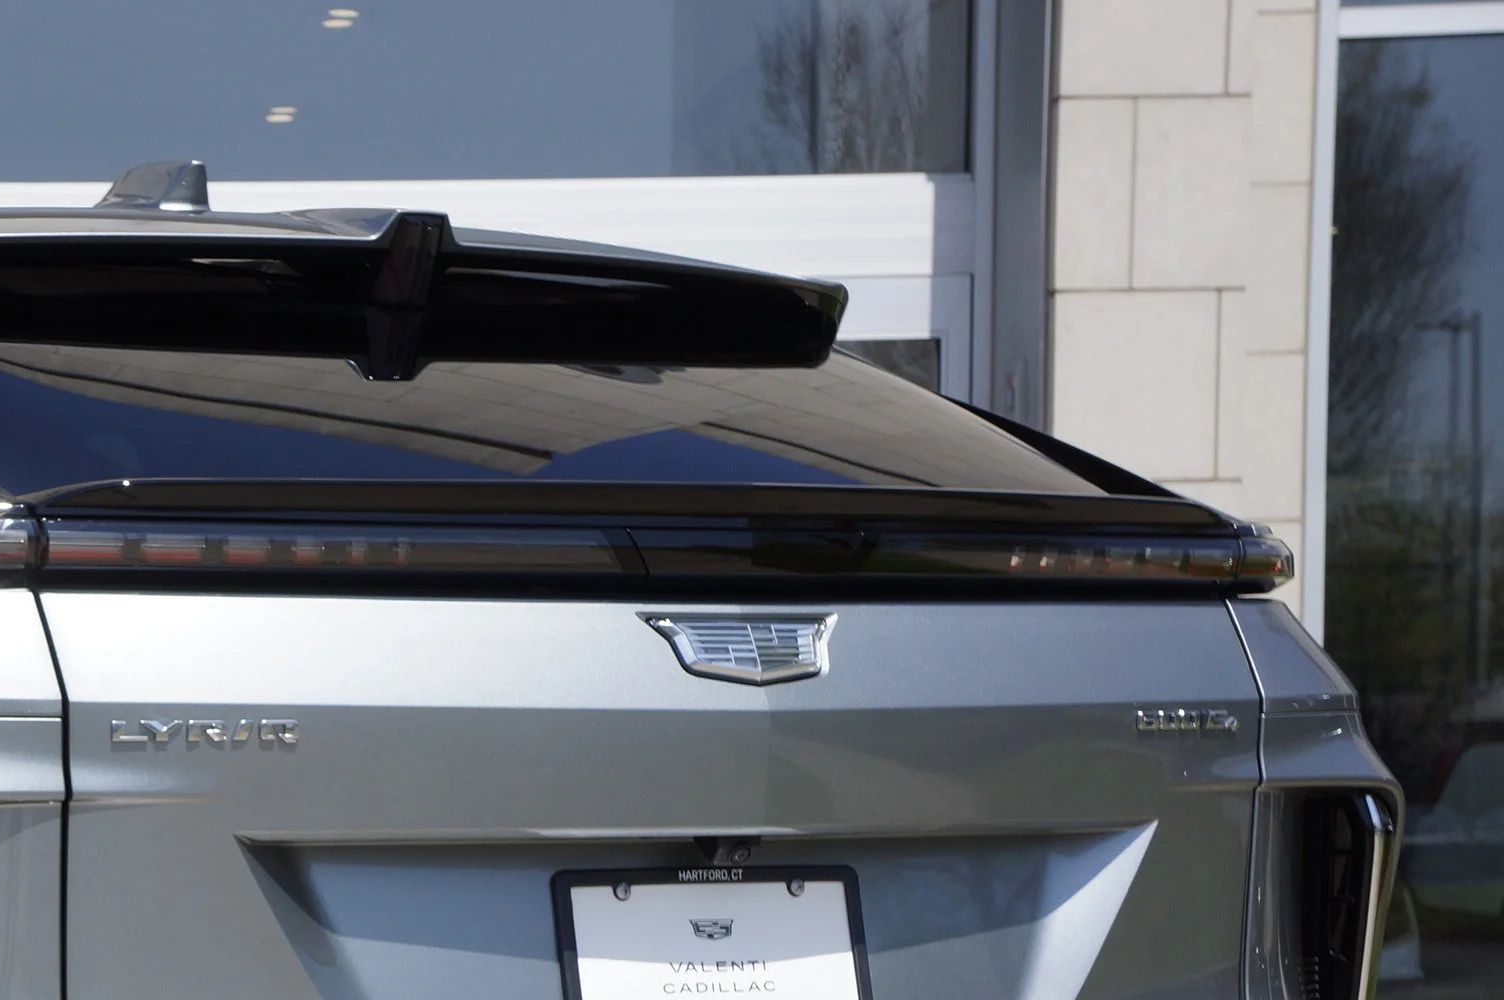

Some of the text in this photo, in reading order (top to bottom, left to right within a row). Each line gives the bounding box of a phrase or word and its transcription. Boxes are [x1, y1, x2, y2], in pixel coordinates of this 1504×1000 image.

[678, 868, 744, 882] HARTFORD, CT
[668, 959, 768, 974] VALENTI
[662, 980, 777, 995] CADILLAC
